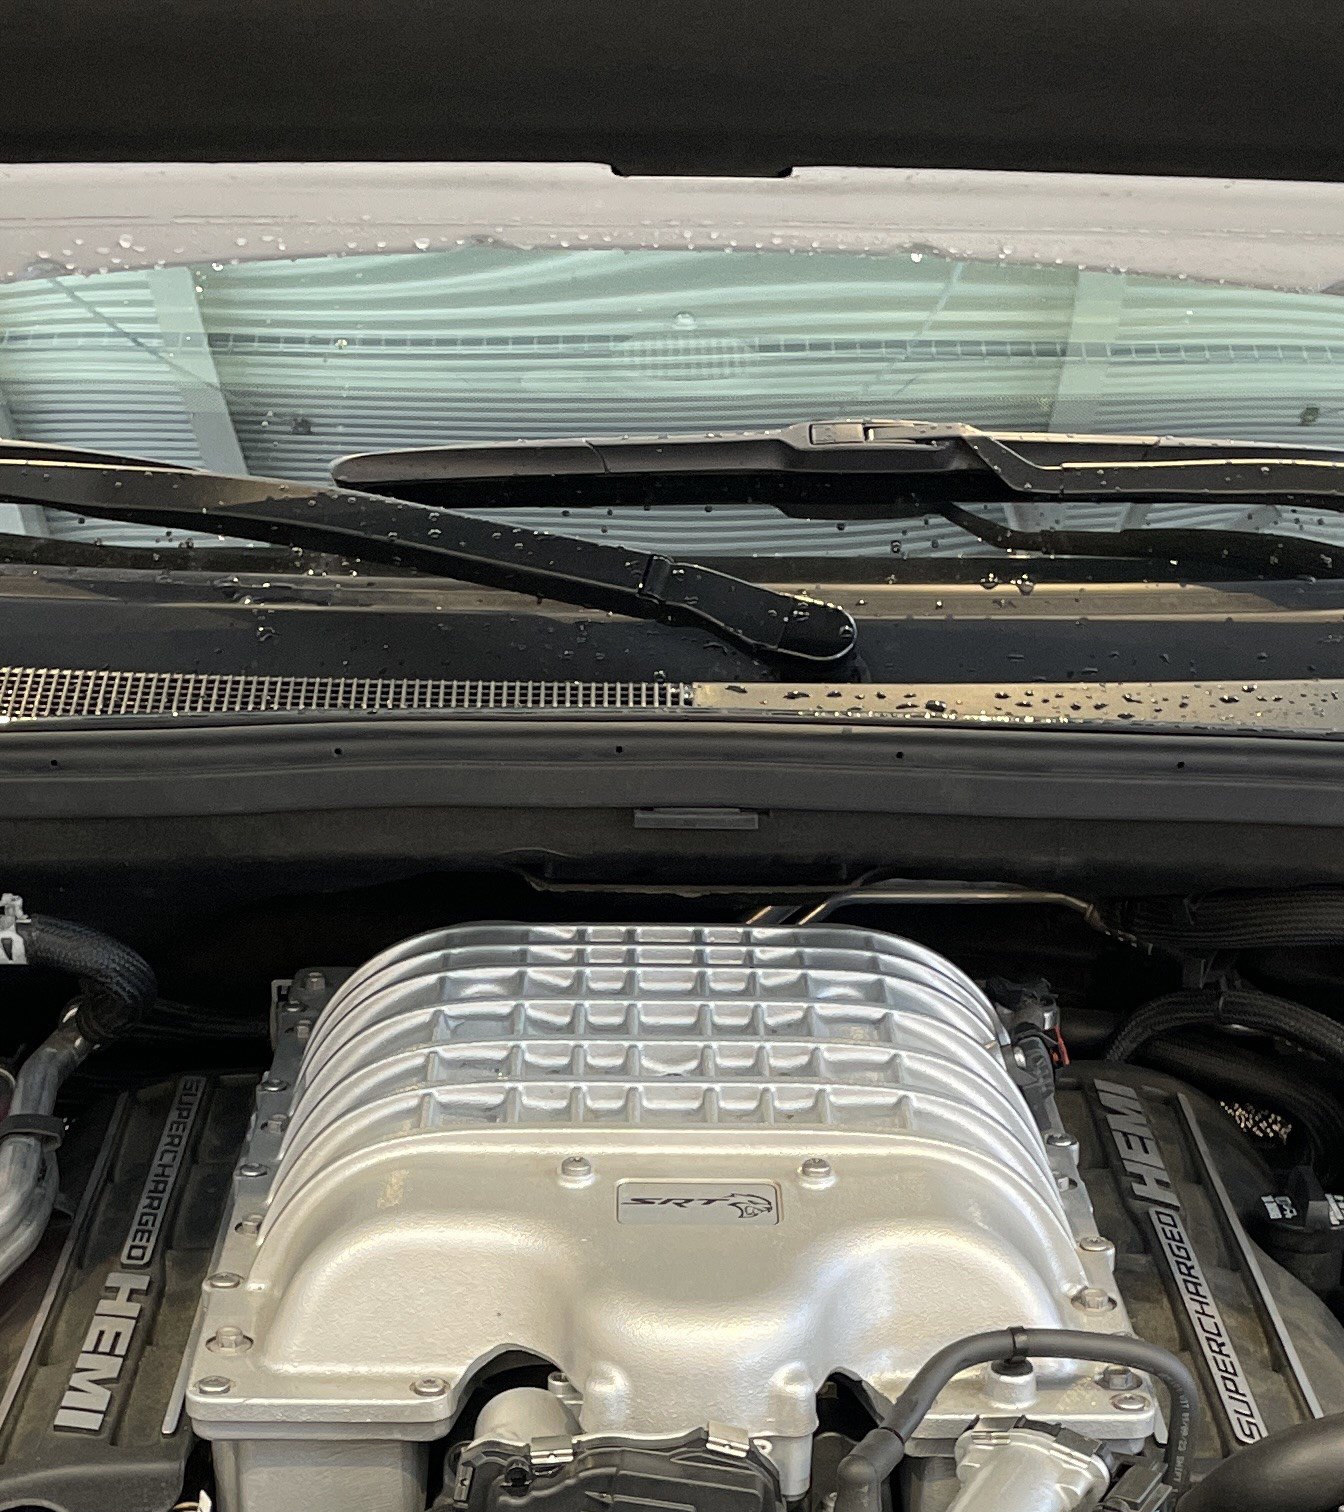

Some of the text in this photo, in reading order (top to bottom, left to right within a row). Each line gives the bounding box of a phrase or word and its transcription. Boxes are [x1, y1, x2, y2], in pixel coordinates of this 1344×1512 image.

[54, 1077, 201, 1431] SUPERCHARGED HEMI
[620, 1197, 732, 1208] SRT
[1094, 1079, 1259, 1441] SUPERCHARGED HEMI
